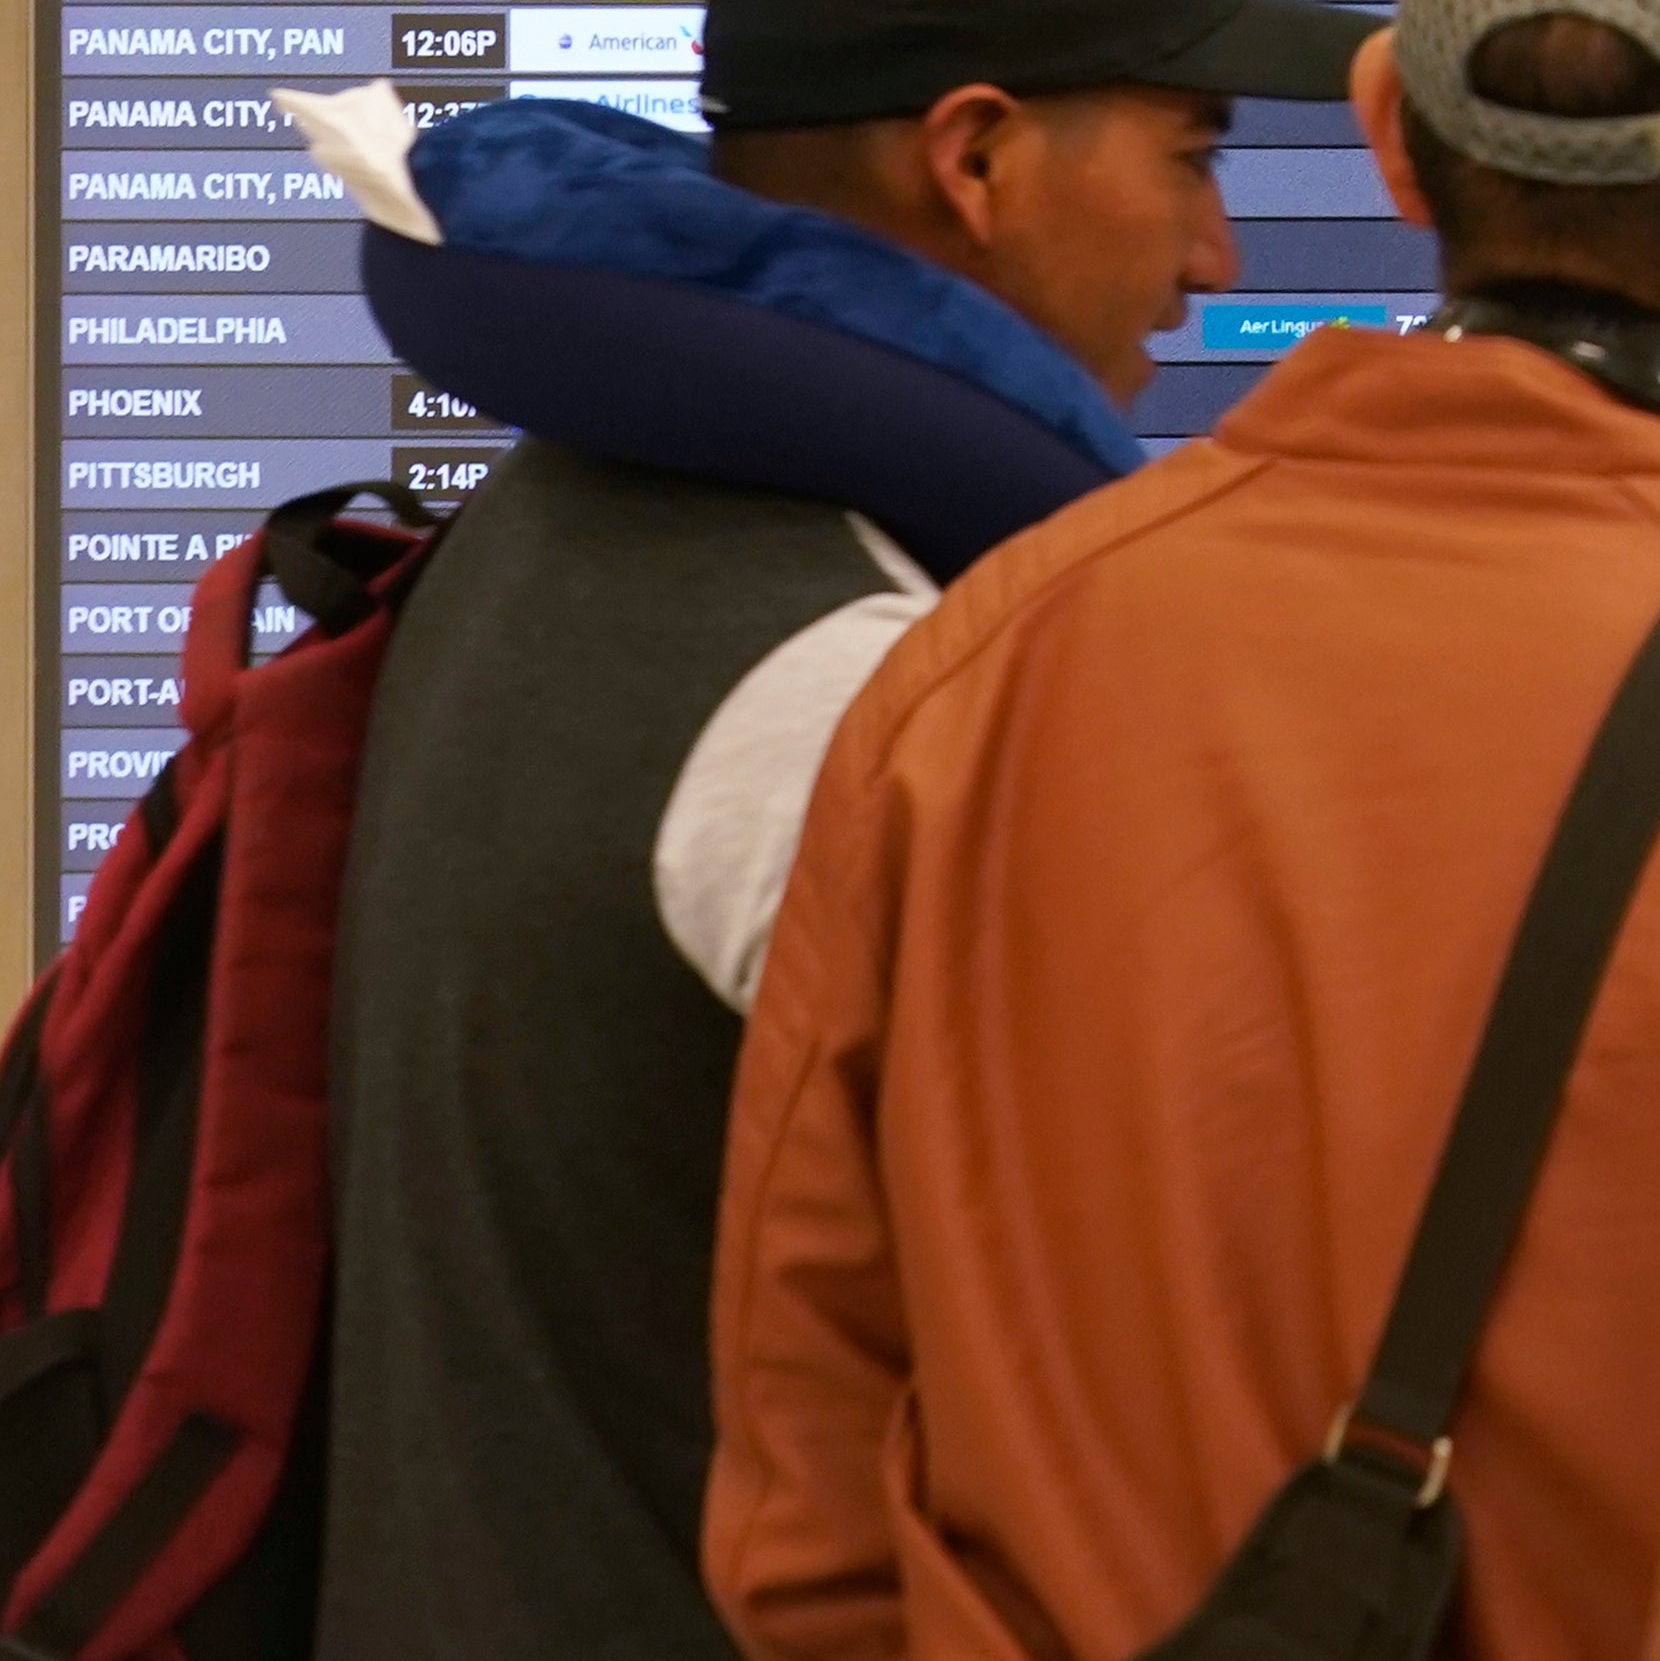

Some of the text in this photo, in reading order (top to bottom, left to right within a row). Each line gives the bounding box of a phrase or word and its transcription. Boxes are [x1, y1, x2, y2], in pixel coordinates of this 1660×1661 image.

[70, 29, 343, 60] PANAMA CITY, PAN
[70, 245, 270, 271] PARAMARIBO
[70, 318, 286, 343] PHILADELPHIA
[69, 390, 202, 416] PHOENIX
[69, 462, 260, 488] PITTSBURGH
